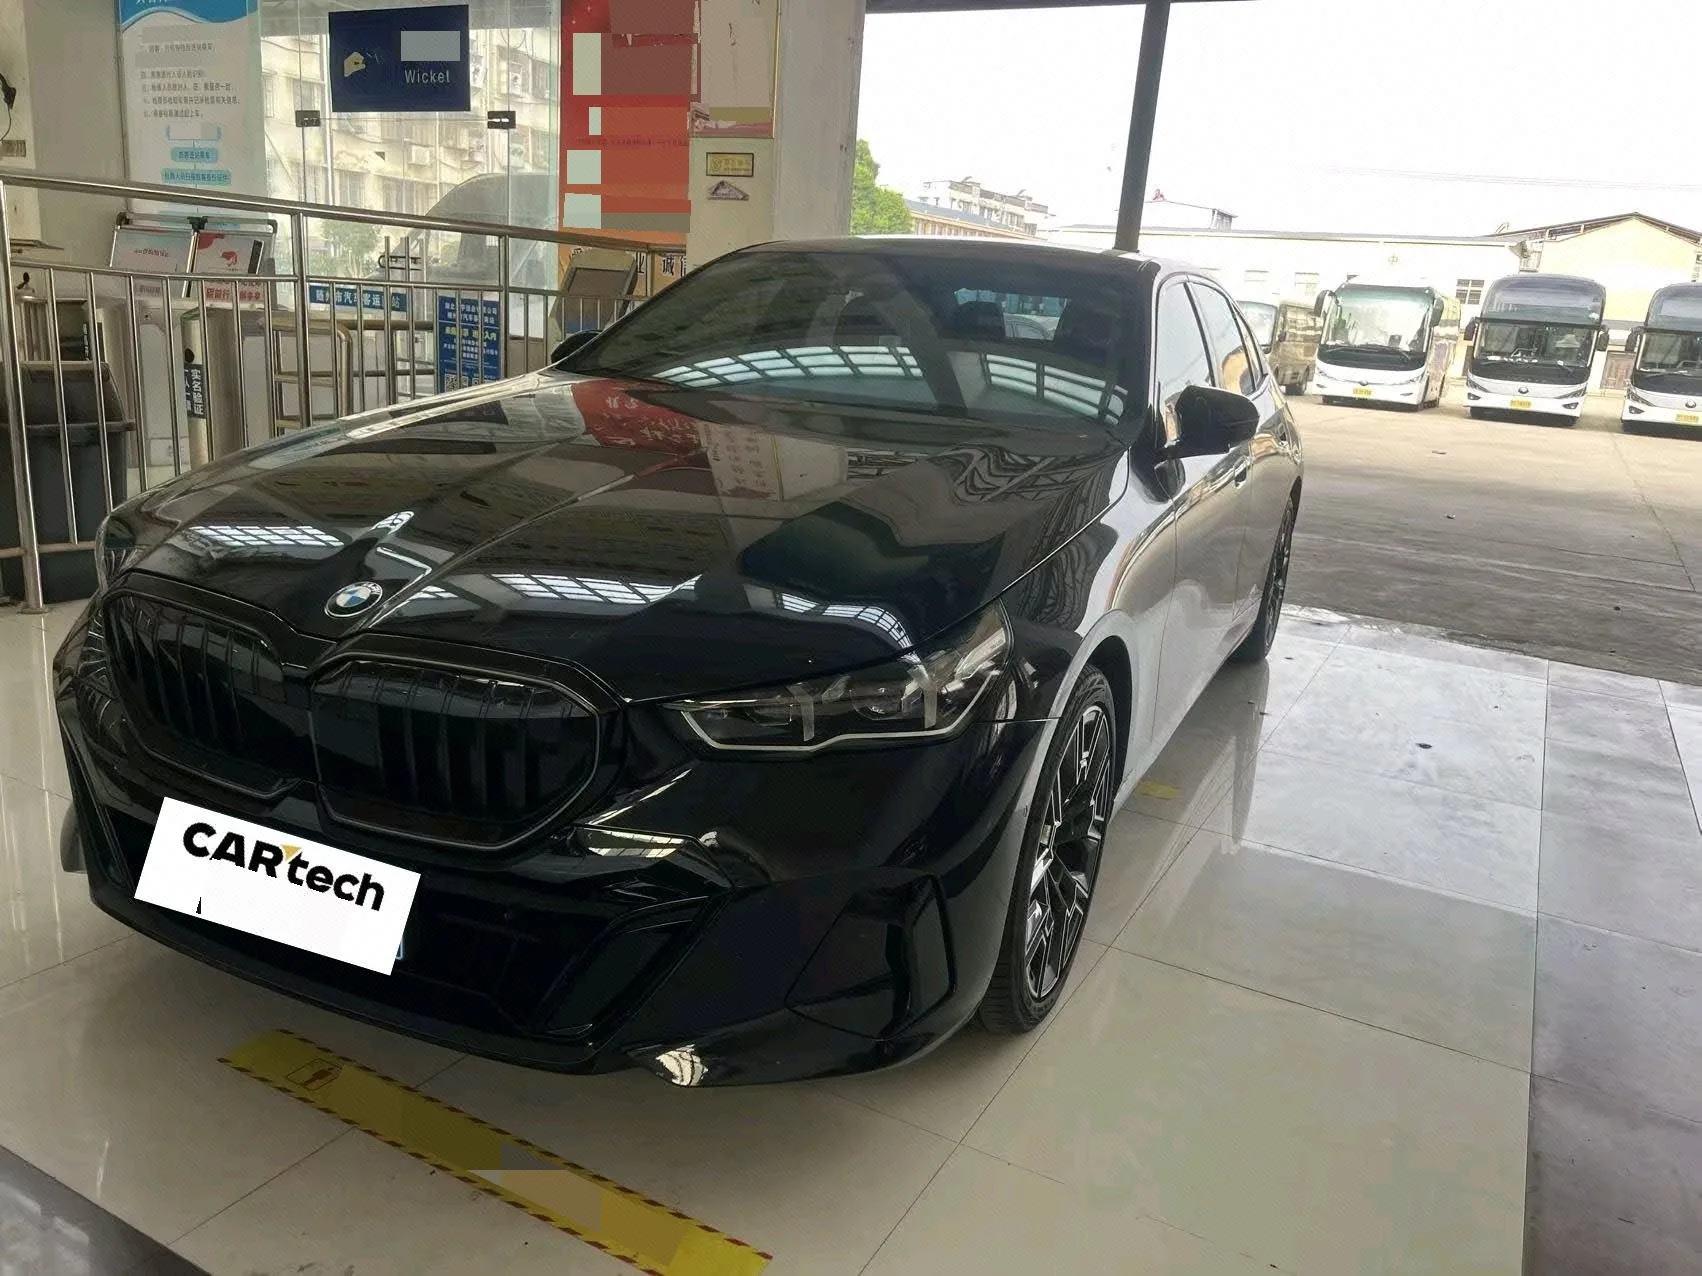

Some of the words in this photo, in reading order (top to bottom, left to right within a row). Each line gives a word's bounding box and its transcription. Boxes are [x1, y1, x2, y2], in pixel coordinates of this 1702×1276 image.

[404, 68, 450, 84] Wicket
[190, 368, 204, 415] 实名验证
